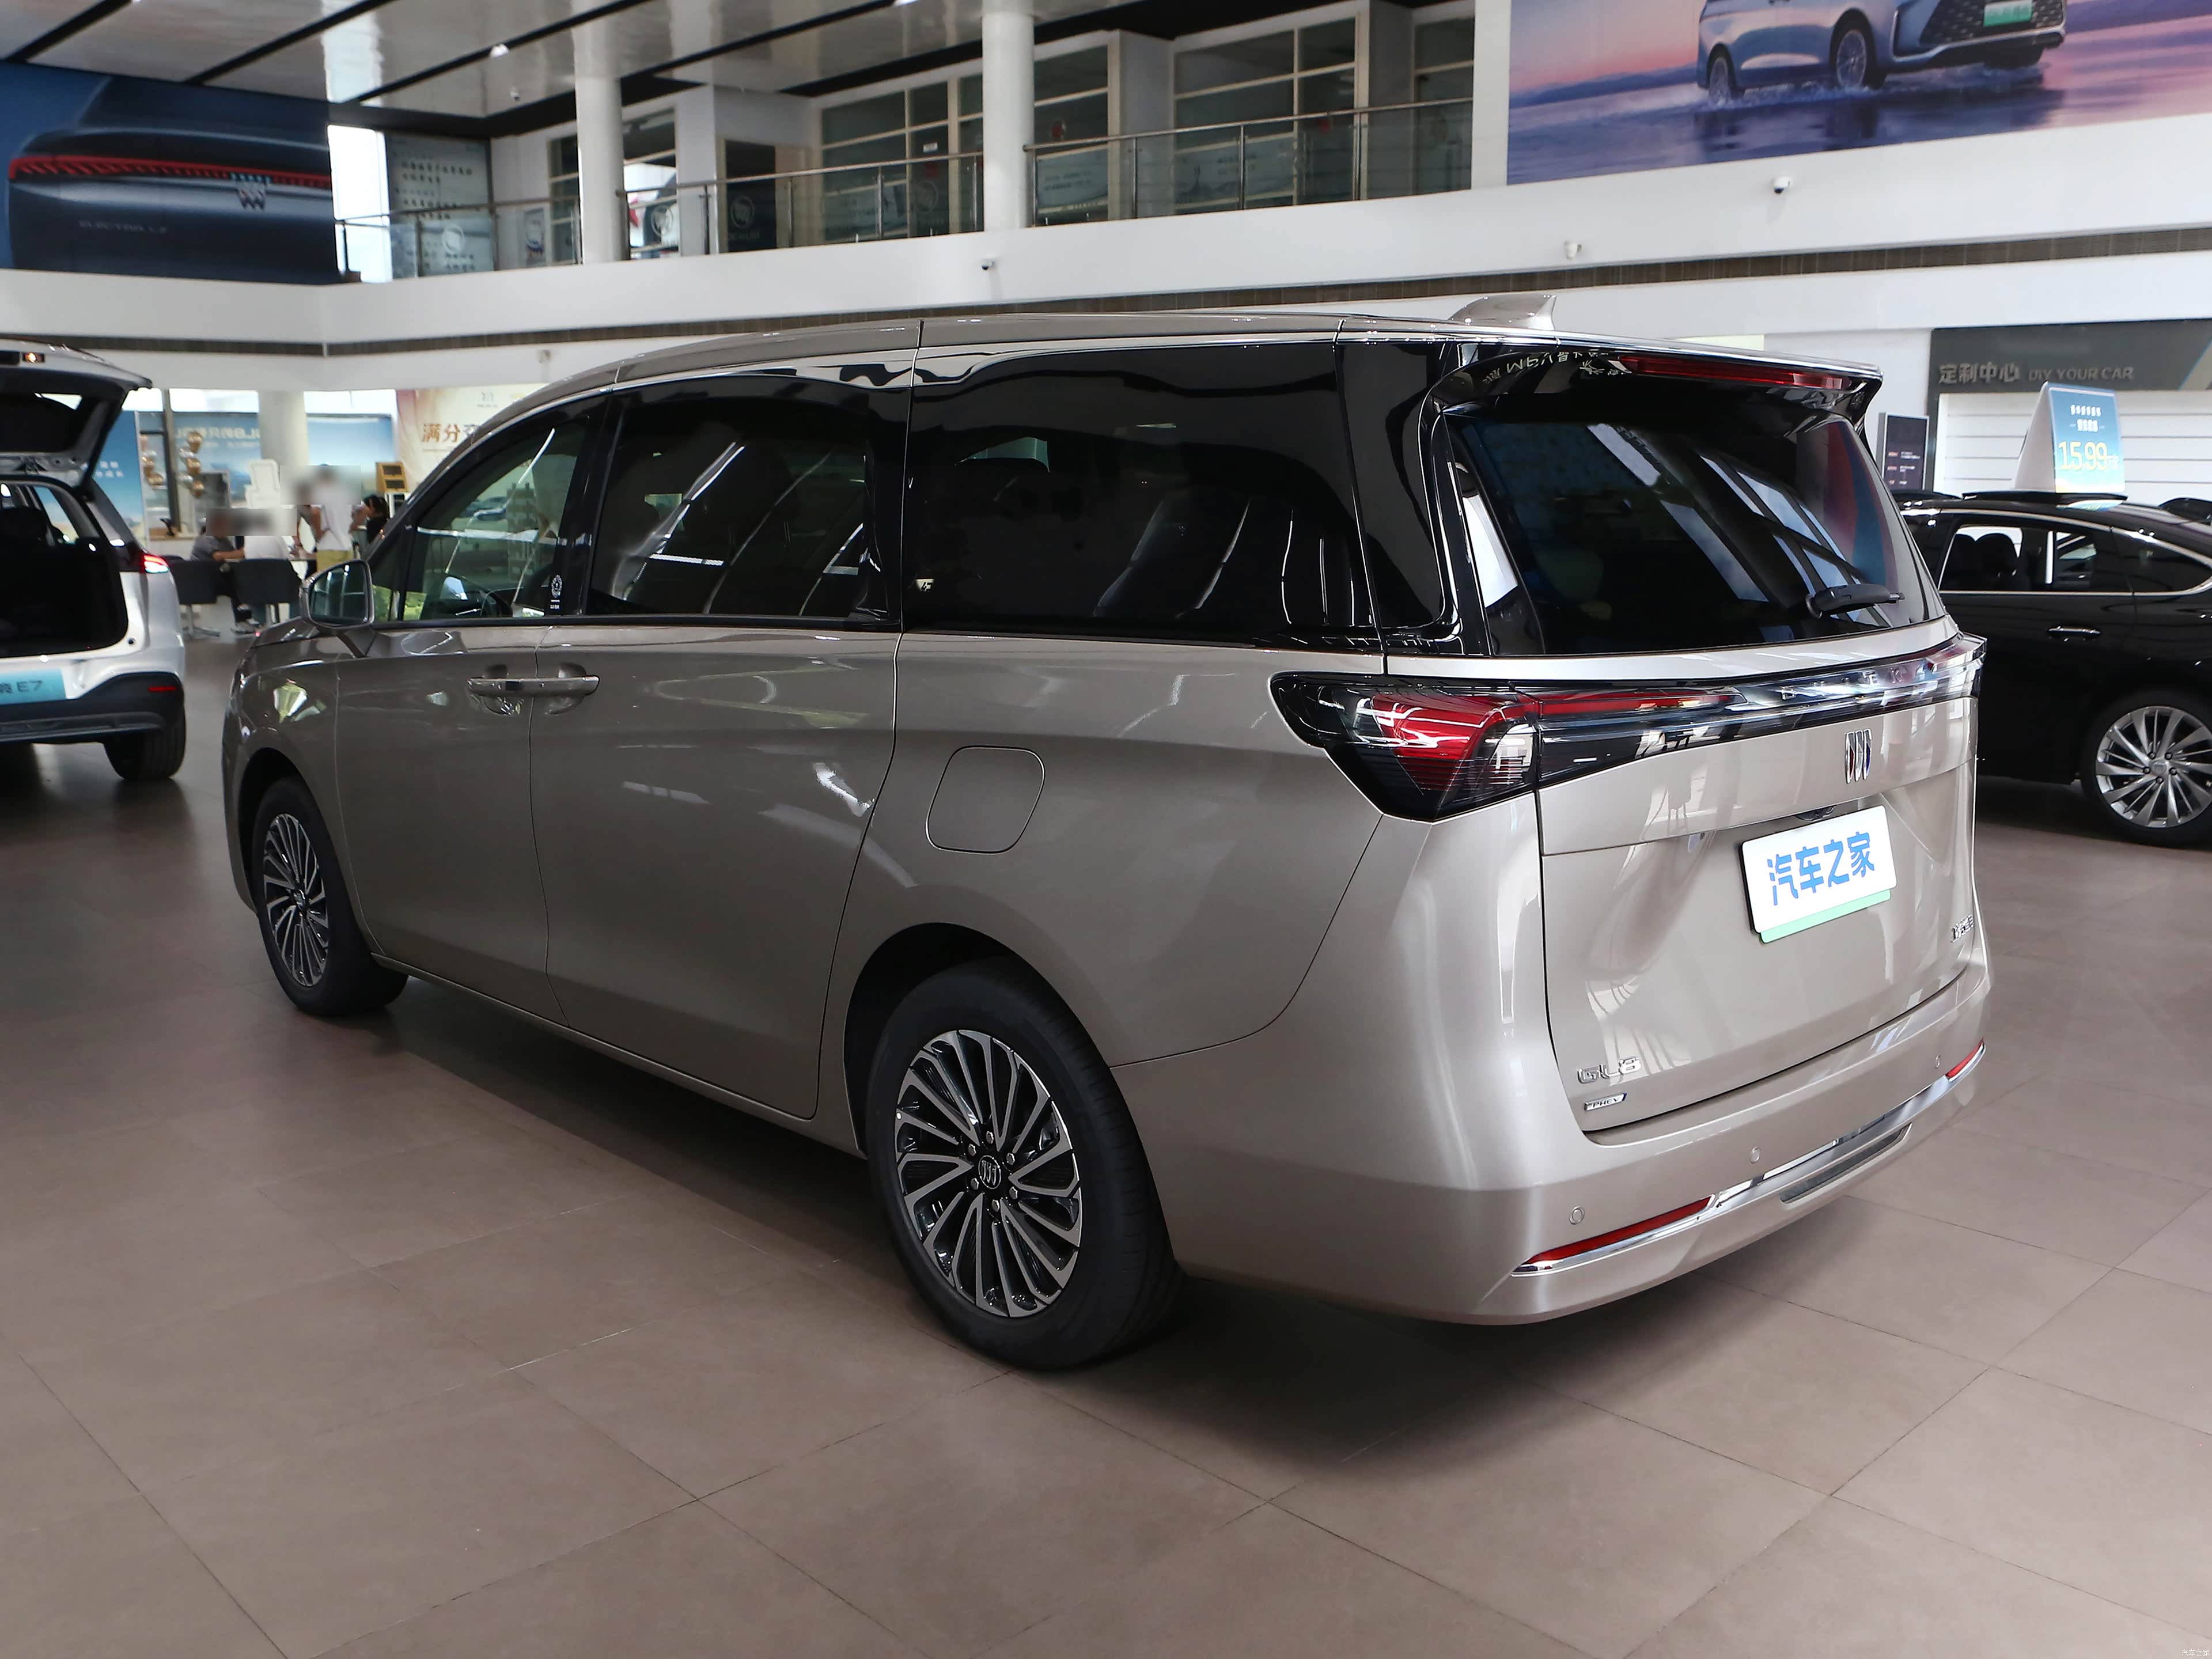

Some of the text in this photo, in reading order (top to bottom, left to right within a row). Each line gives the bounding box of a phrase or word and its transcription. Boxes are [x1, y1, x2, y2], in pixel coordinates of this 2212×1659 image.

[1938, 362, 2020, 384] 定制中心
[2056, 368, 2099, 381] YOUR
[2101, 366, 2134, 380] CAR
[1577, 1056, 1642, 1084] GL8
[1592, 1096, 1620, 1108] PHEV
